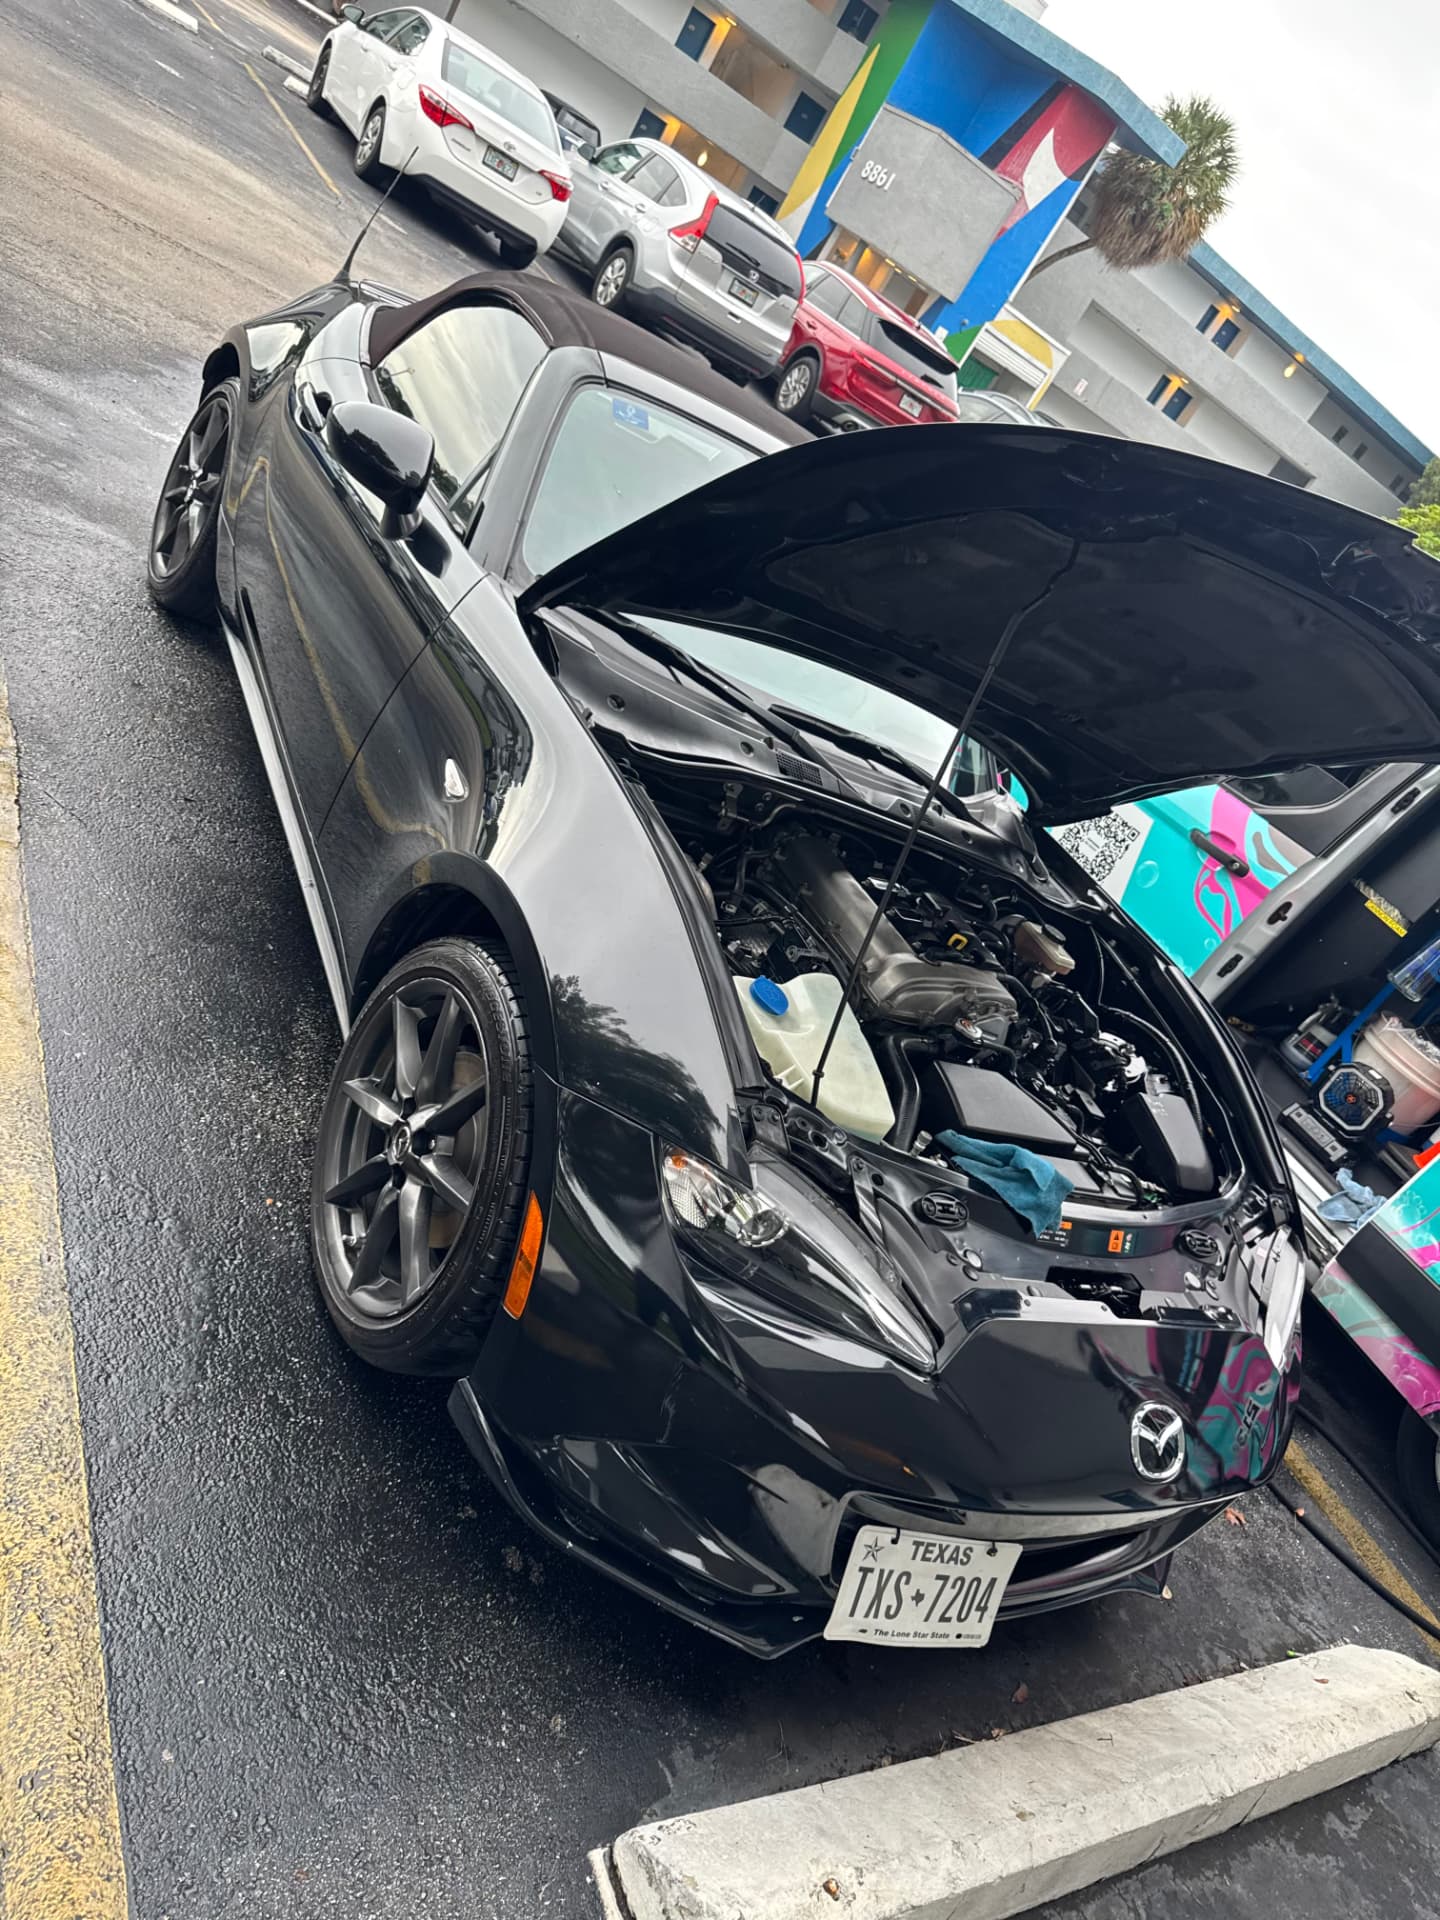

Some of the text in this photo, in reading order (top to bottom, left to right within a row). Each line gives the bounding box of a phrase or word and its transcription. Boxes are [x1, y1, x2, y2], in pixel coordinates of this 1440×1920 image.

[861, 160, 896, 190] 8861
[911, 1540, 974, 1566] TEXAS
[848, 1566, 998, 1624] TXS 7204
[873, 1628, 950, 1640] The Lone Star State
